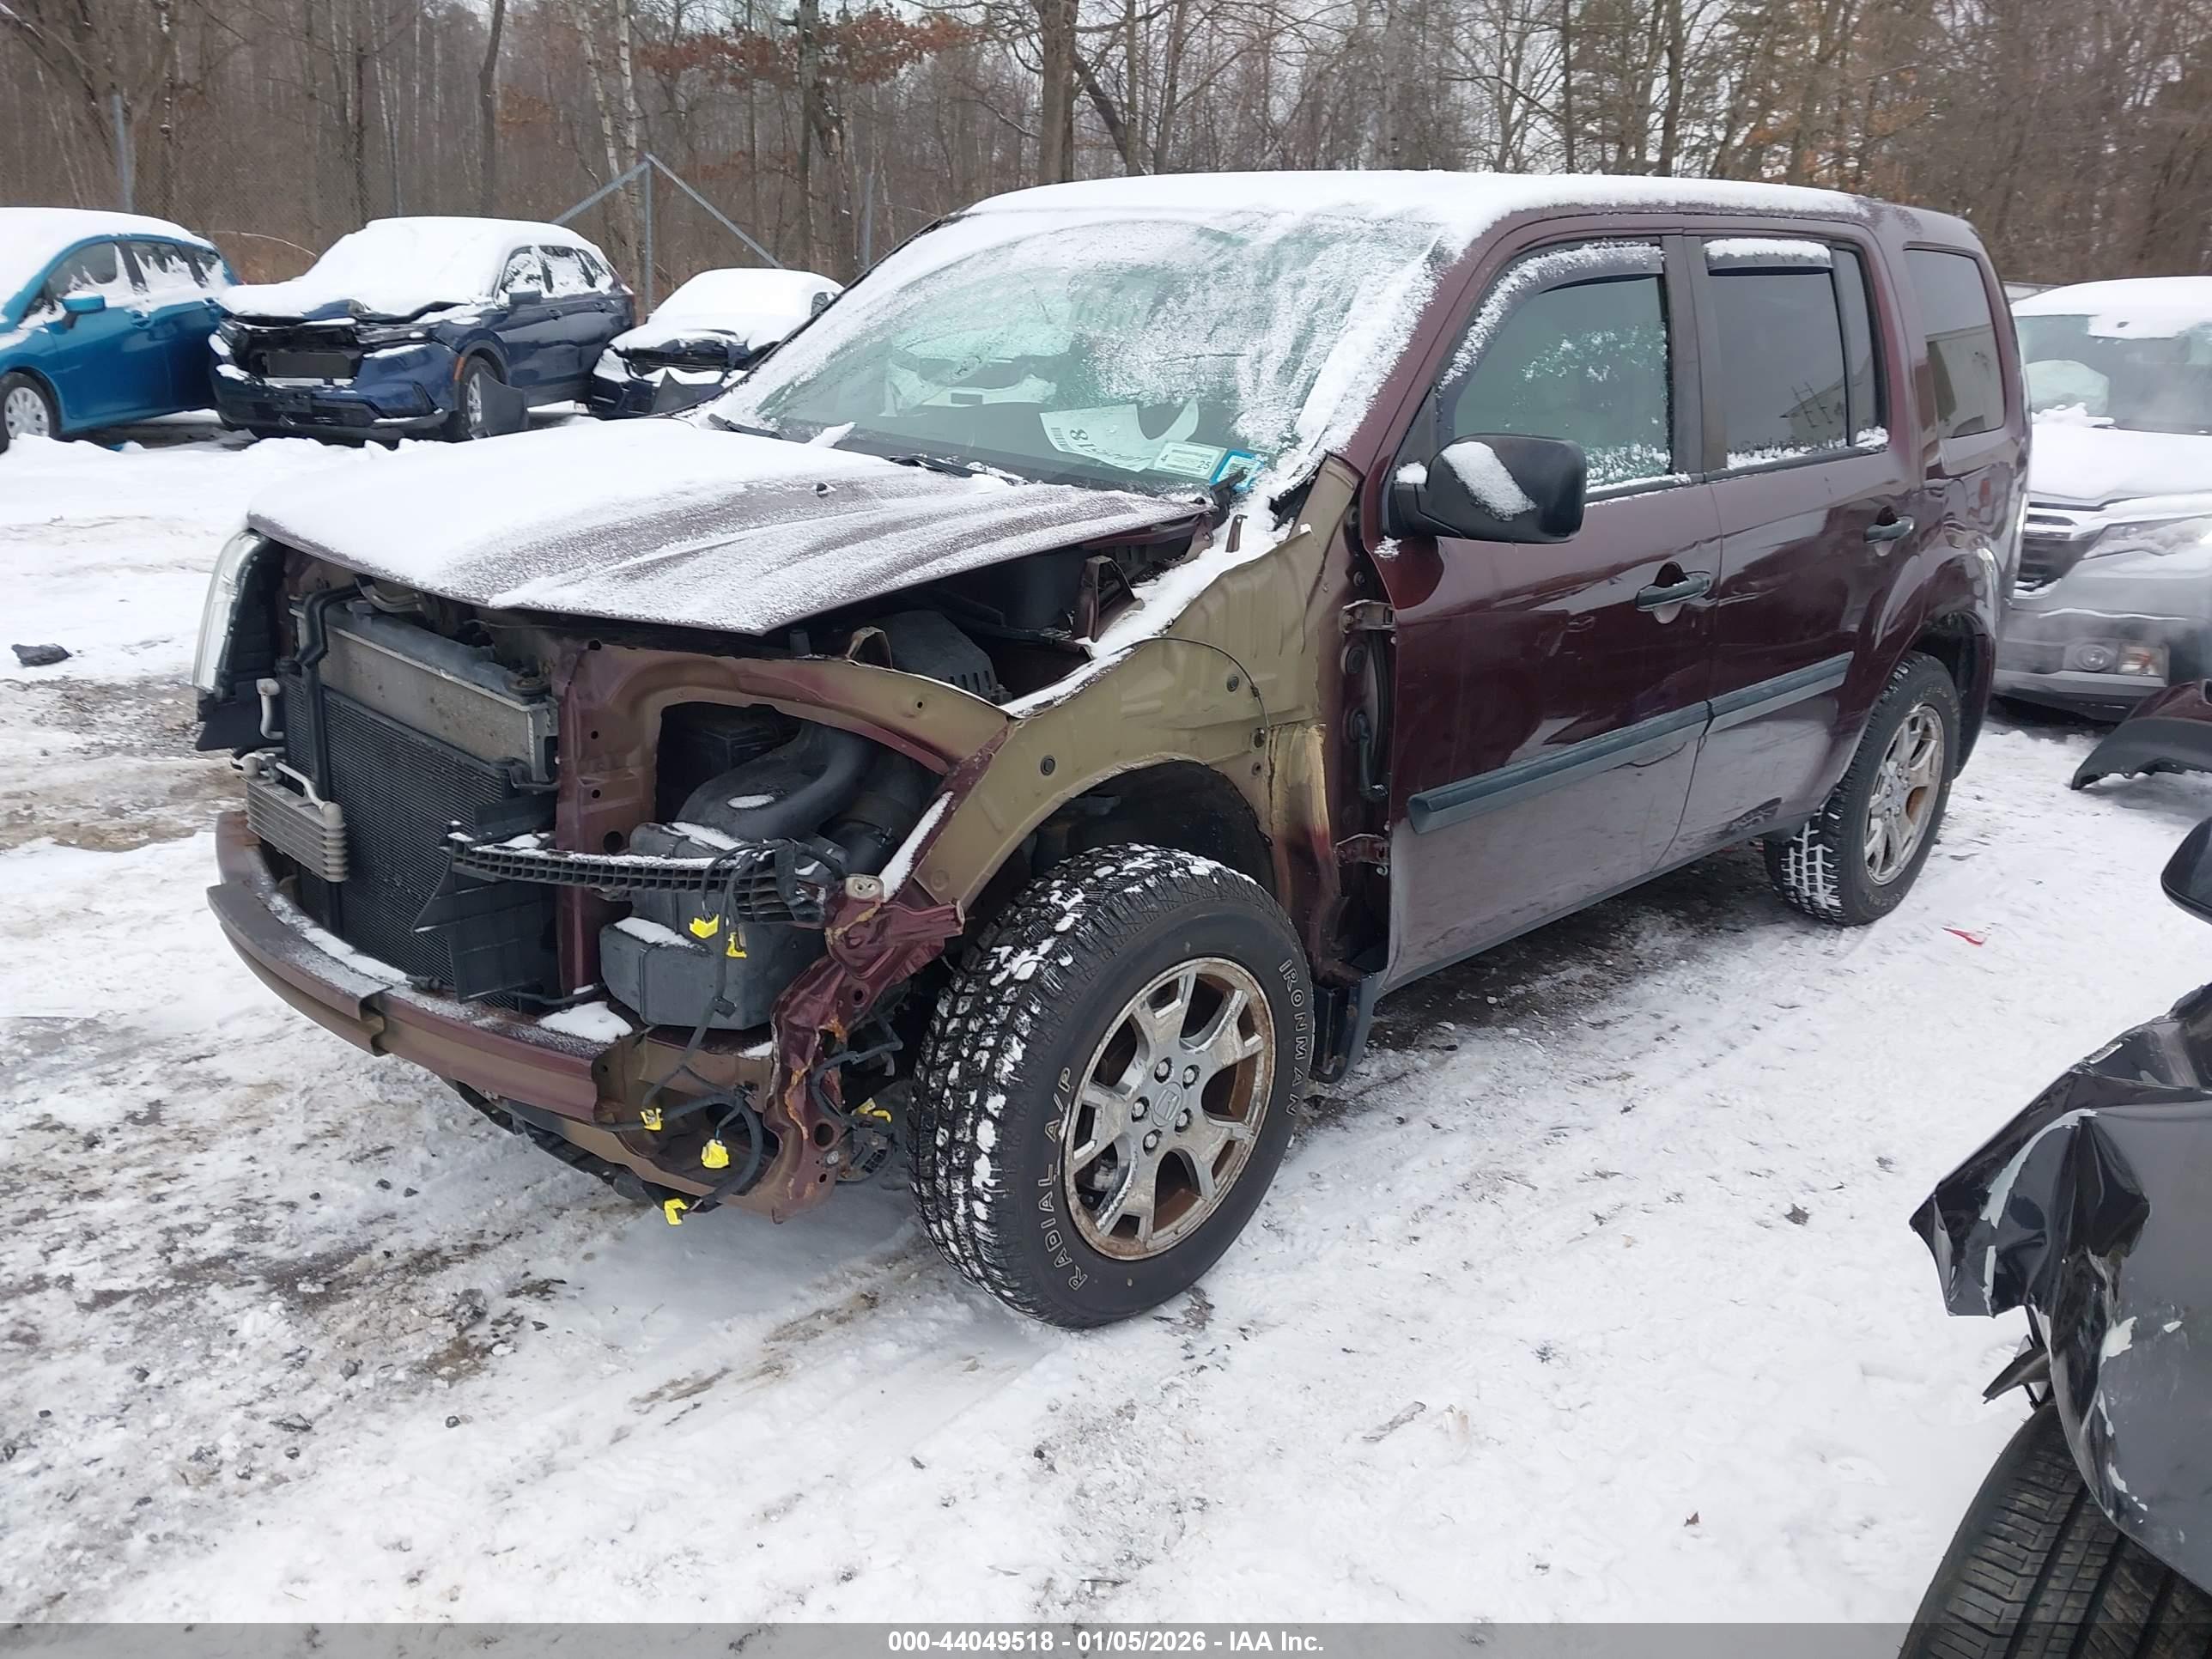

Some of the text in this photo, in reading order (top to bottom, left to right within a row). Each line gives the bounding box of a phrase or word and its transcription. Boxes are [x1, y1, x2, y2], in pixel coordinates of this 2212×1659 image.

[1197, 460, 1212, 470] 25
[1278, 958, 1309, 1116] IRONMAN
[1037, 1066, 1089, 1291] RADIAL A/P
